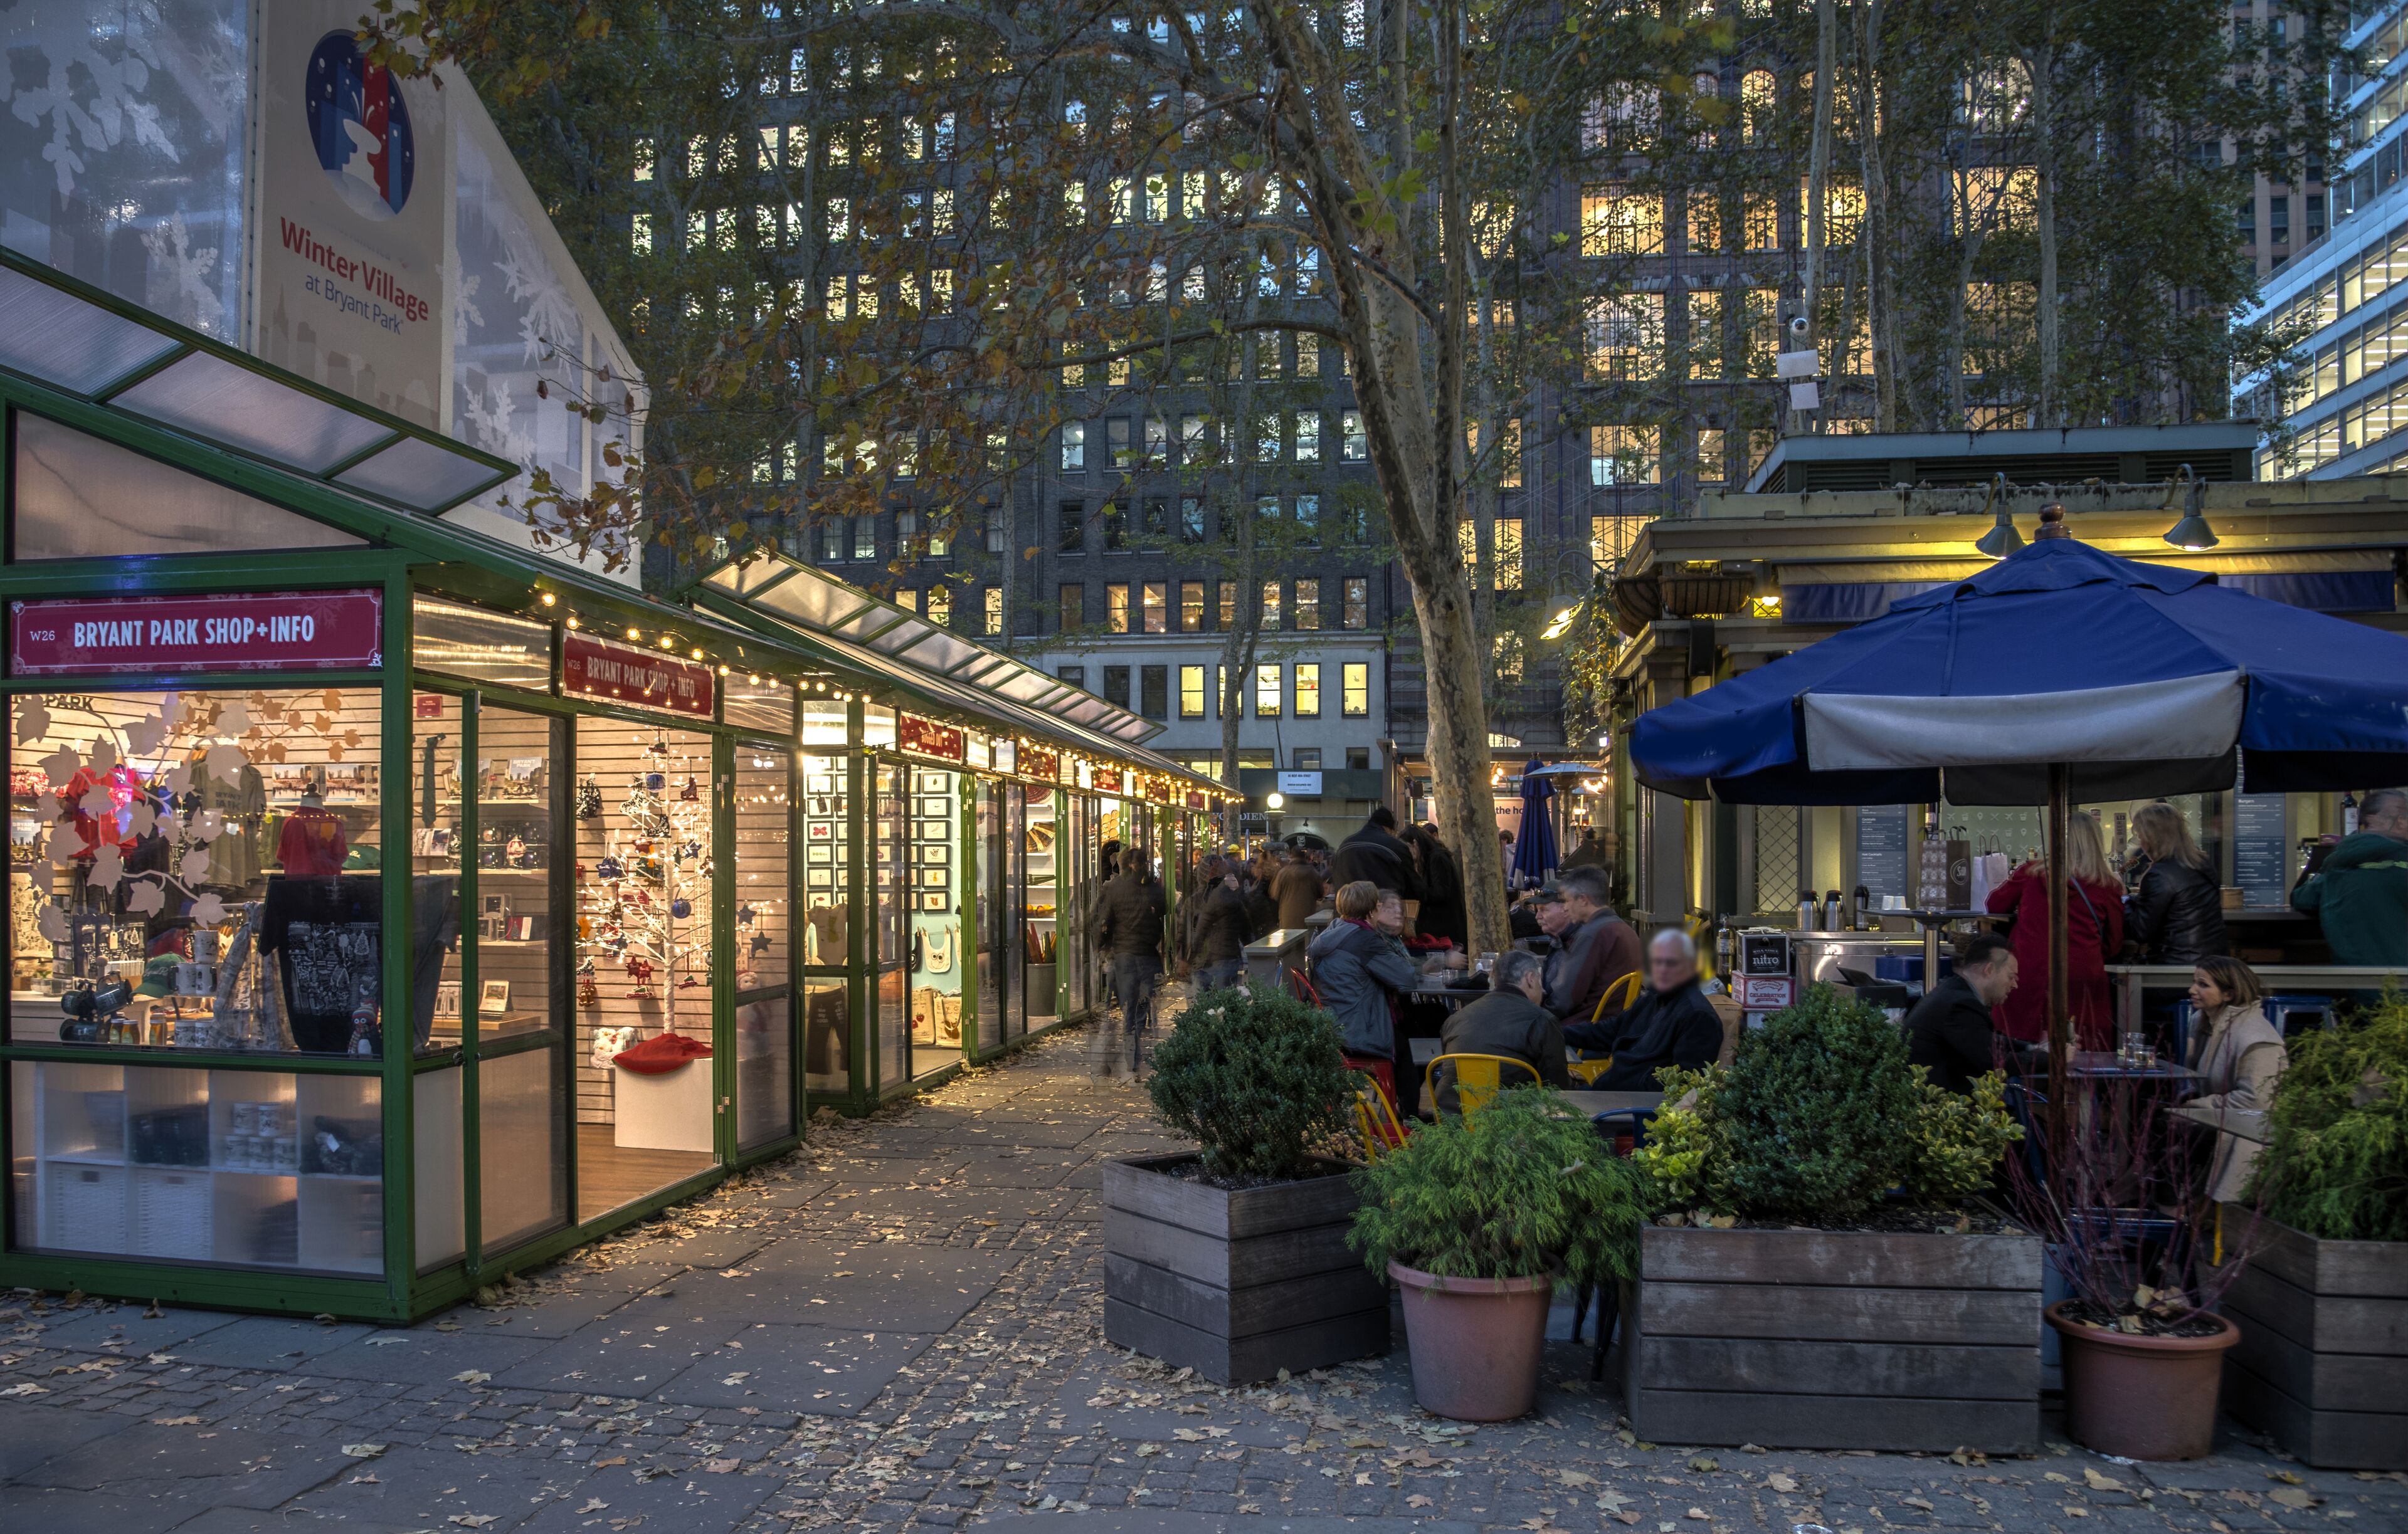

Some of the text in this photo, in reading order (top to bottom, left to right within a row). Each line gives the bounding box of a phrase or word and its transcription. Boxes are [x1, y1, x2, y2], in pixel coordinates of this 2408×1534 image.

[281, 216, 358, 282] Winter
[362, 261, 428, 322] Village
[305, 275, 320, 295] at
[325, 279, 369, 320] Bryant
[29, 630, 55, 641] W26
[74, 621, 144, 647] BRYANT
[150, 618, 200, 646] PARK
[567, 658, 581, 670] W26
[587, 656, 621, 684] BRYANT
[624, 664, 646, 688] PARK
[648, 670, 668, 693] SHOP
[678, 676, 695, 698] INFO
[45, 695, 93, 711] PARK
[1496, 806, 1511, 814] the
[1752, 953, 1779, 964] nitro
